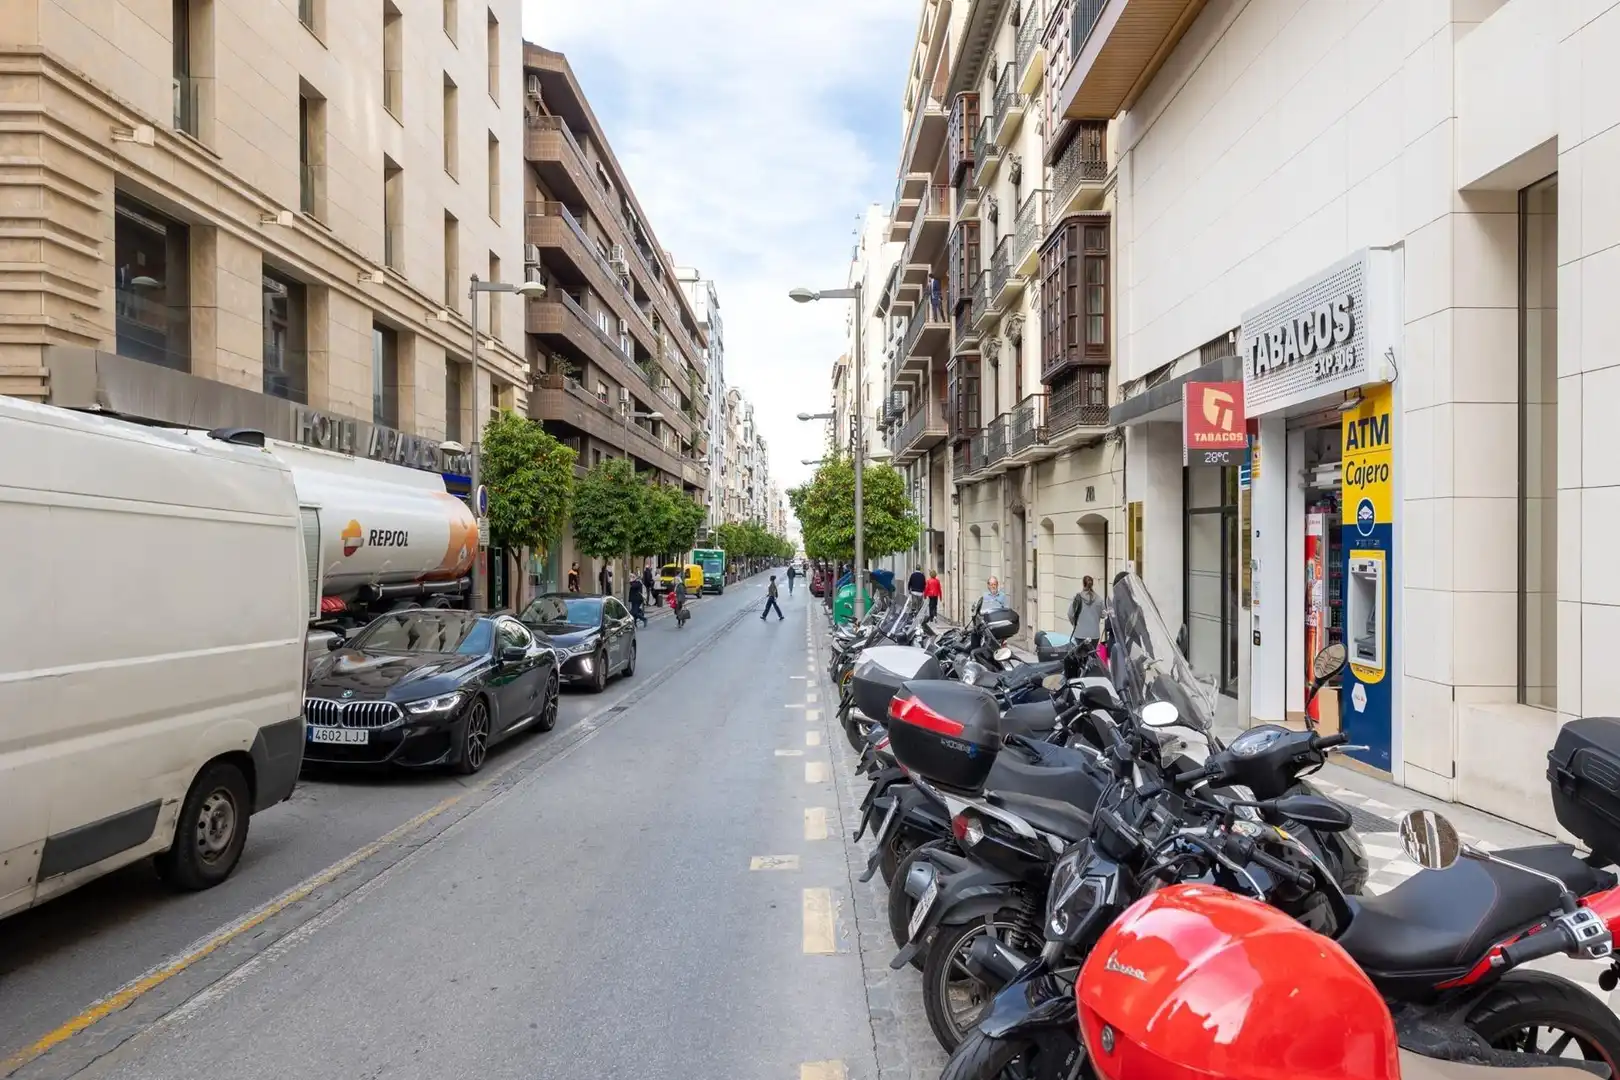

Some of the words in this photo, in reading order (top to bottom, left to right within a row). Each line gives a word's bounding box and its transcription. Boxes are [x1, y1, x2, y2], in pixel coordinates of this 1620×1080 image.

[1247, 294, 1355, 376] TABACOS
[1194, 432, 1243, 442] TABACOS
[1346, 413, 1389, 451] ATM
[1345, 459, 1389, 490] Cajero
[368, 529, 408, 547] REPSOL
[315, 730, 342, 742] 4602
[345, 731, 366, 742] LJJ
